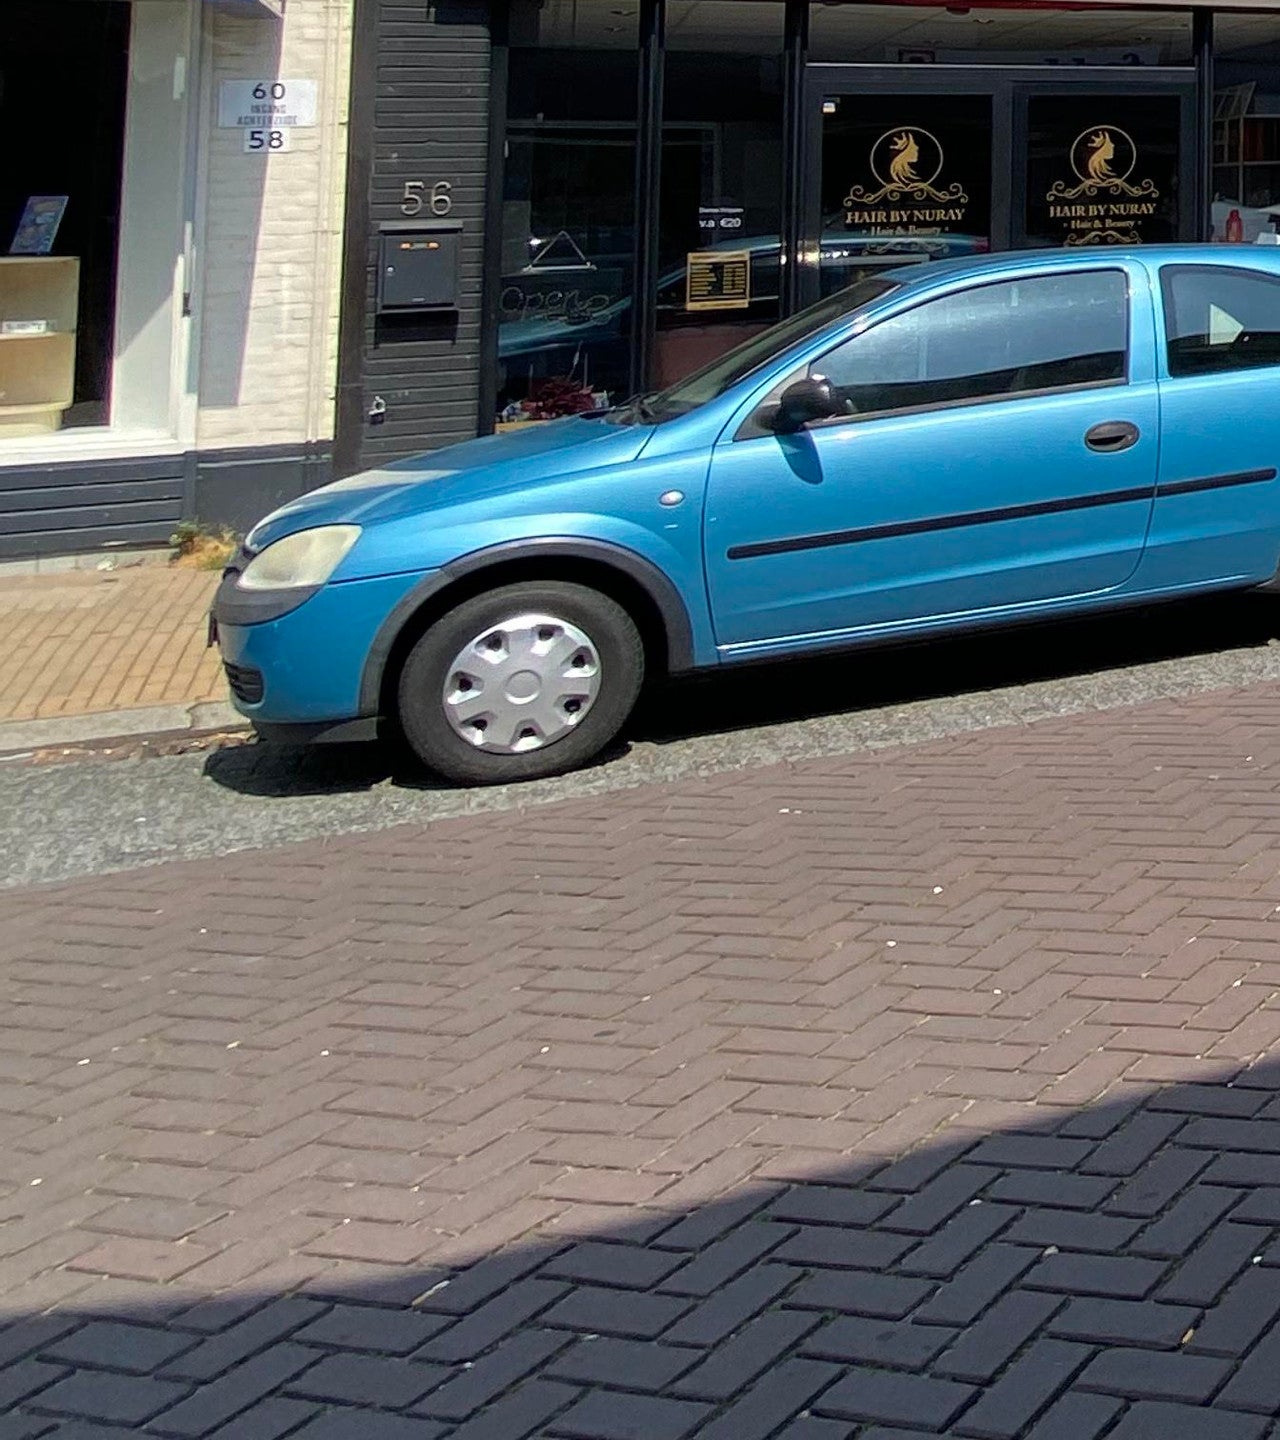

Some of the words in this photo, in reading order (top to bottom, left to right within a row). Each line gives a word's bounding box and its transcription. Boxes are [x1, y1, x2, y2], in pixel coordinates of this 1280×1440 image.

[252, 82, 286, 100] 60
[249, 130, 284, 149] 58
[401, 180, 452, 216] 56
[845, 210, 887, 224] HAIR
[889, 210, 910, 223] BY
[912, 207, 966, 221] NURAY
[1049, 205, 1086, 218] HAIR
[1088, 204, 1107, 216] BY
[1108, 202, 1157, 215] NURAY
